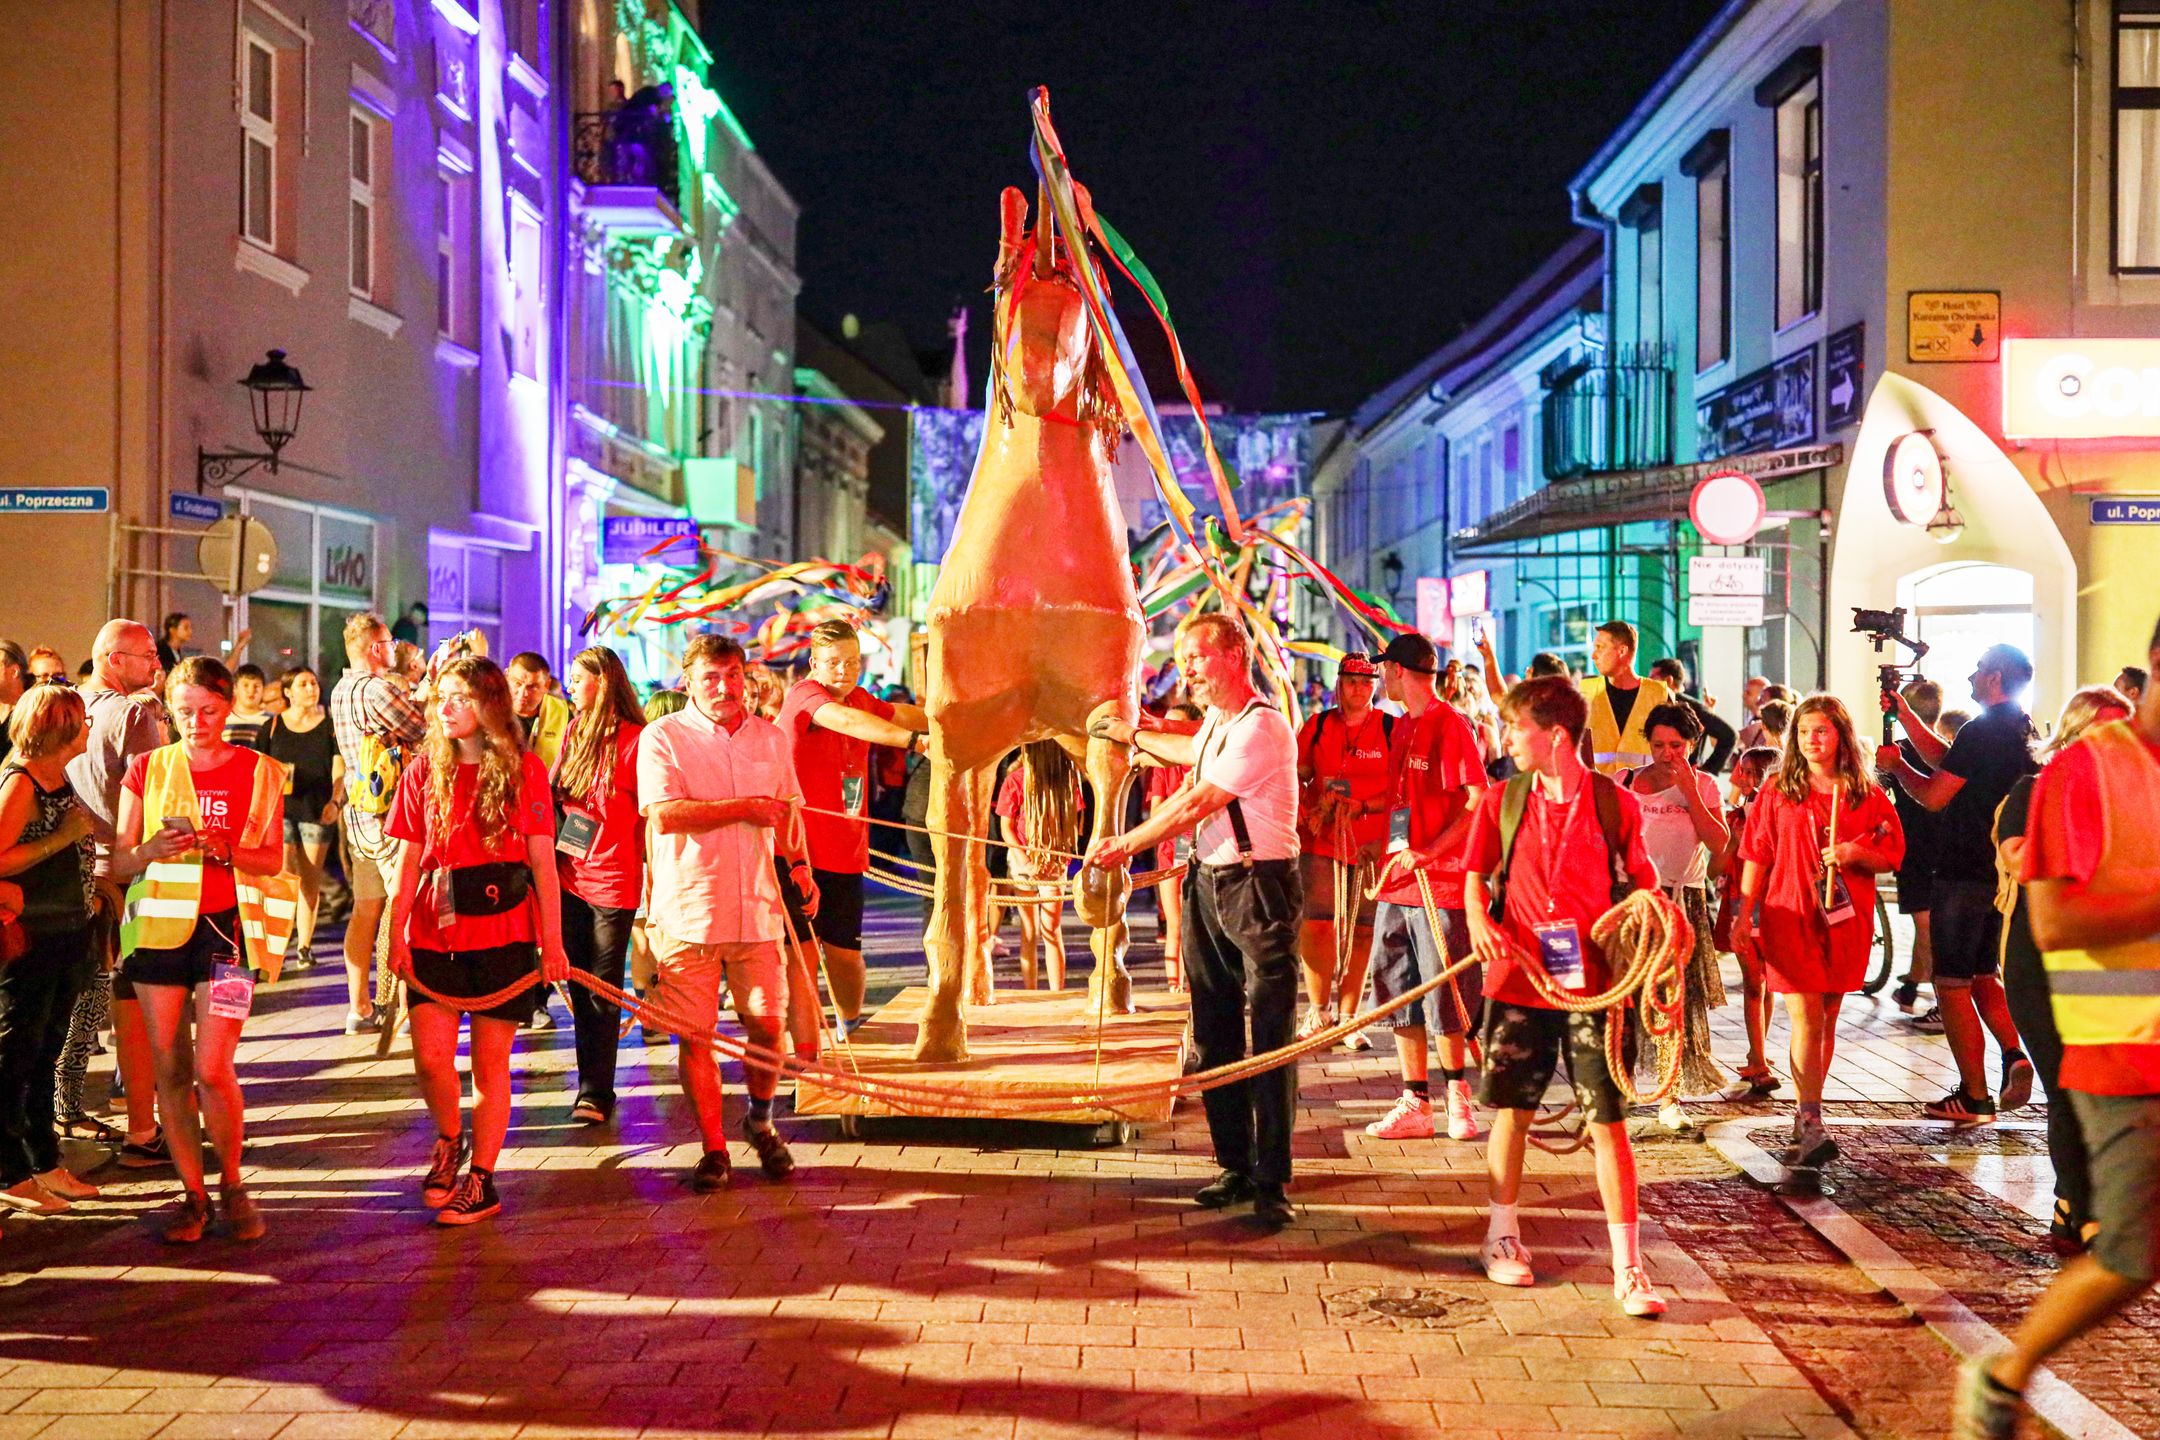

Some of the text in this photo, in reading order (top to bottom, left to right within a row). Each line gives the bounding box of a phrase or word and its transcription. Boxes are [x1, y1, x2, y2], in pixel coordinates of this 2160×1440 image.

[16, 494, 94, 508] Poprzeczna
[2107, 506, 2124, 518] ul.
[609, 521, 690, 535] JUBILER
[1719, 562, 1759, 571] dotyczy
